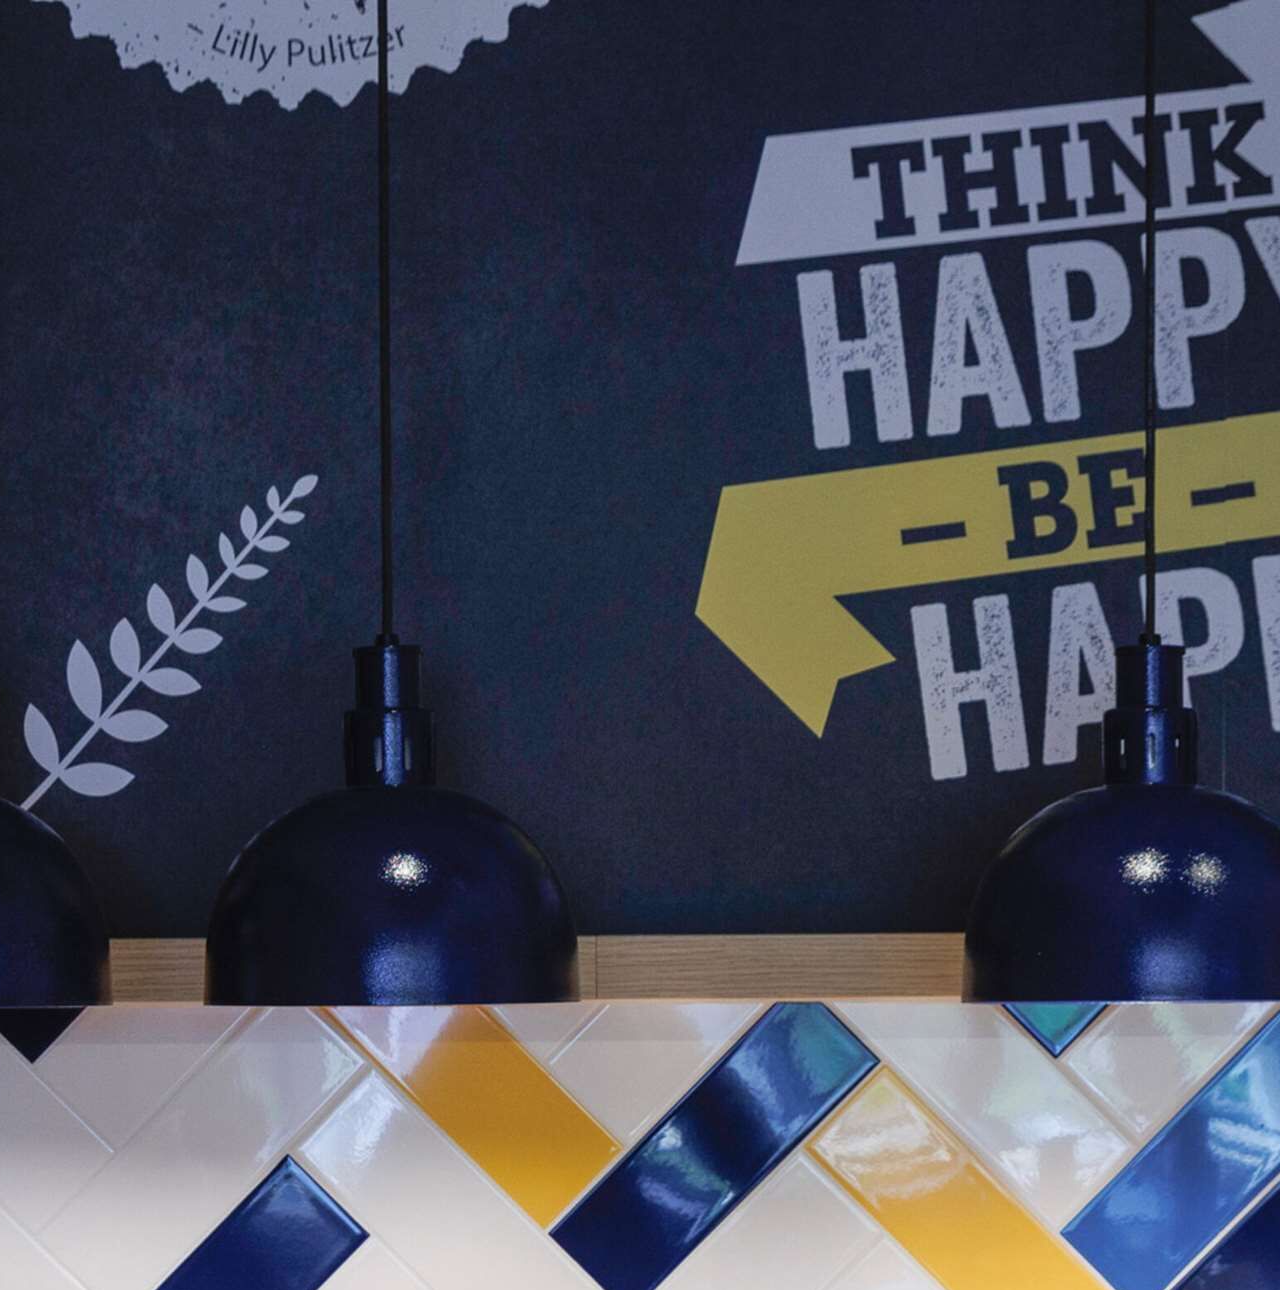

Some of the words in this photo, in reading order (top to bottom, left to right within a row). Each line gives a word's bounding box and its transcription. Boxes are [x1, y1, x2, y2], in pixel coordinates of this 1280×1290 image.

[212, 24, 277, 72] Lilly
[287, 25, 405, 67] Pulitzer
[851, 101, 1273, 240] THINK
[997, 448, 1148, 561] BE
